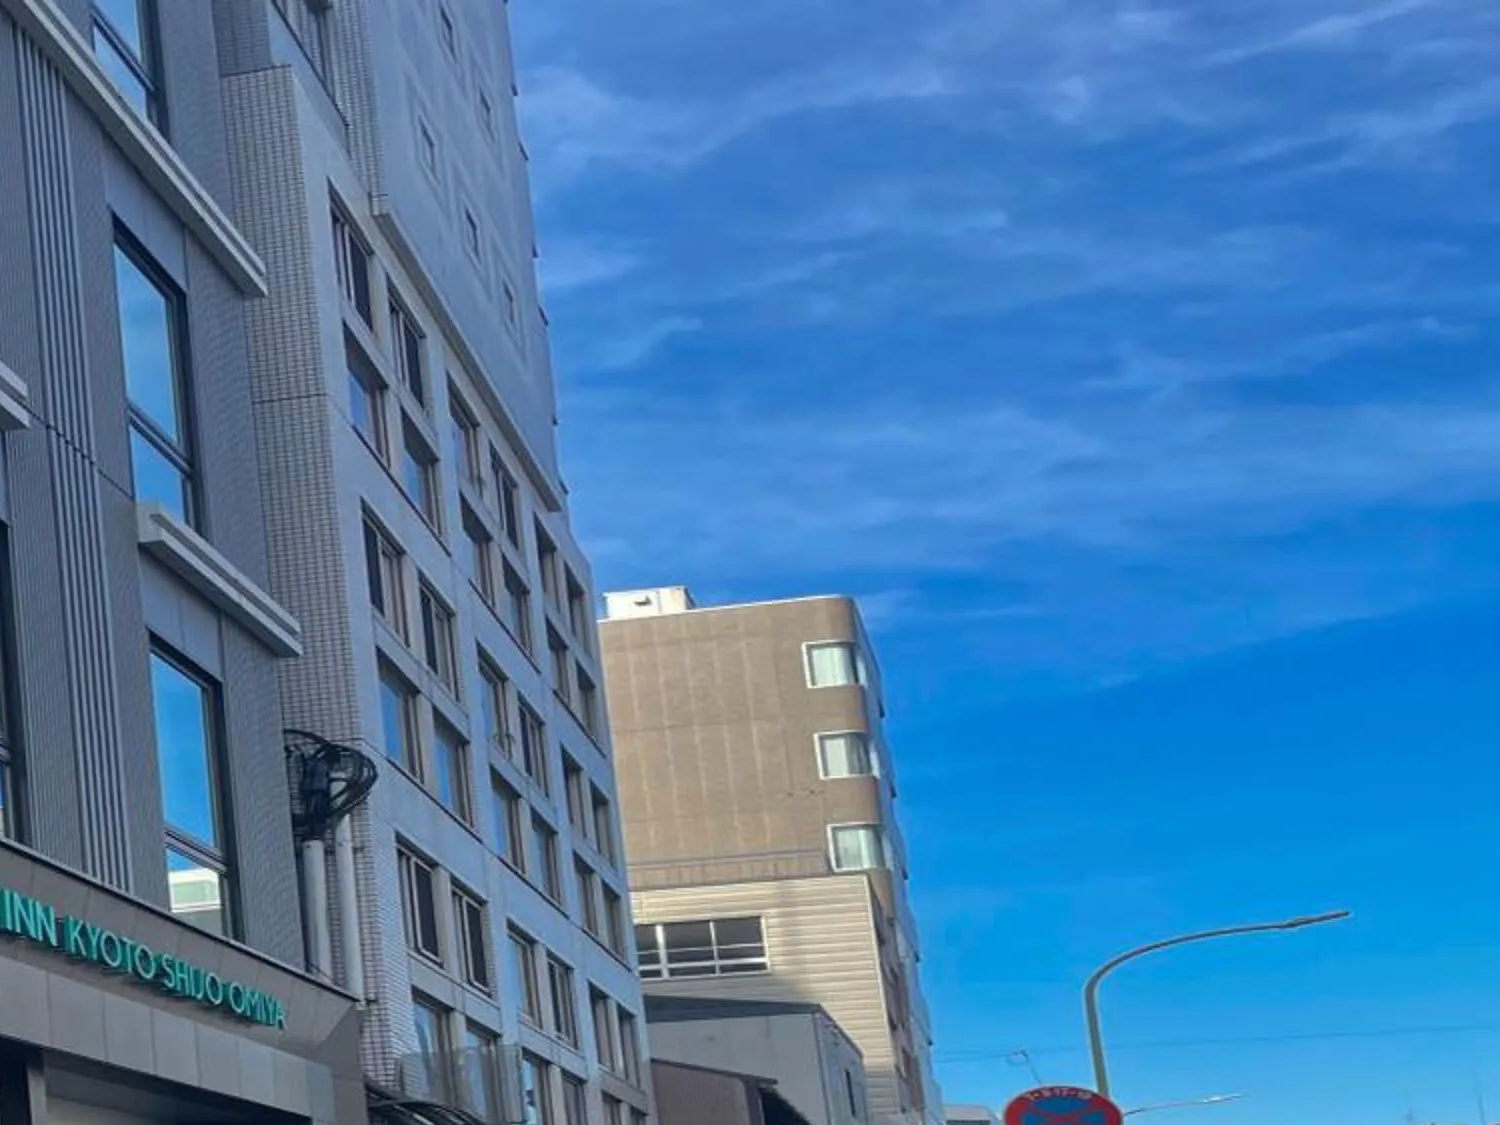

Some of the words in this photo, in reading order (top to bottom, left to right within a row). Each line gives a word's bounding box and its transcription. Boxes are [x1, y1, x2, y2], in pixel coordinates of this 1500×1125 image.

[0, 887, 58, 947] INN
[63, 916, 156, 979] KYOTO
[159, 953, 223, 1005] SHIJO
[228, 981, 287, 1030] OMIYA
